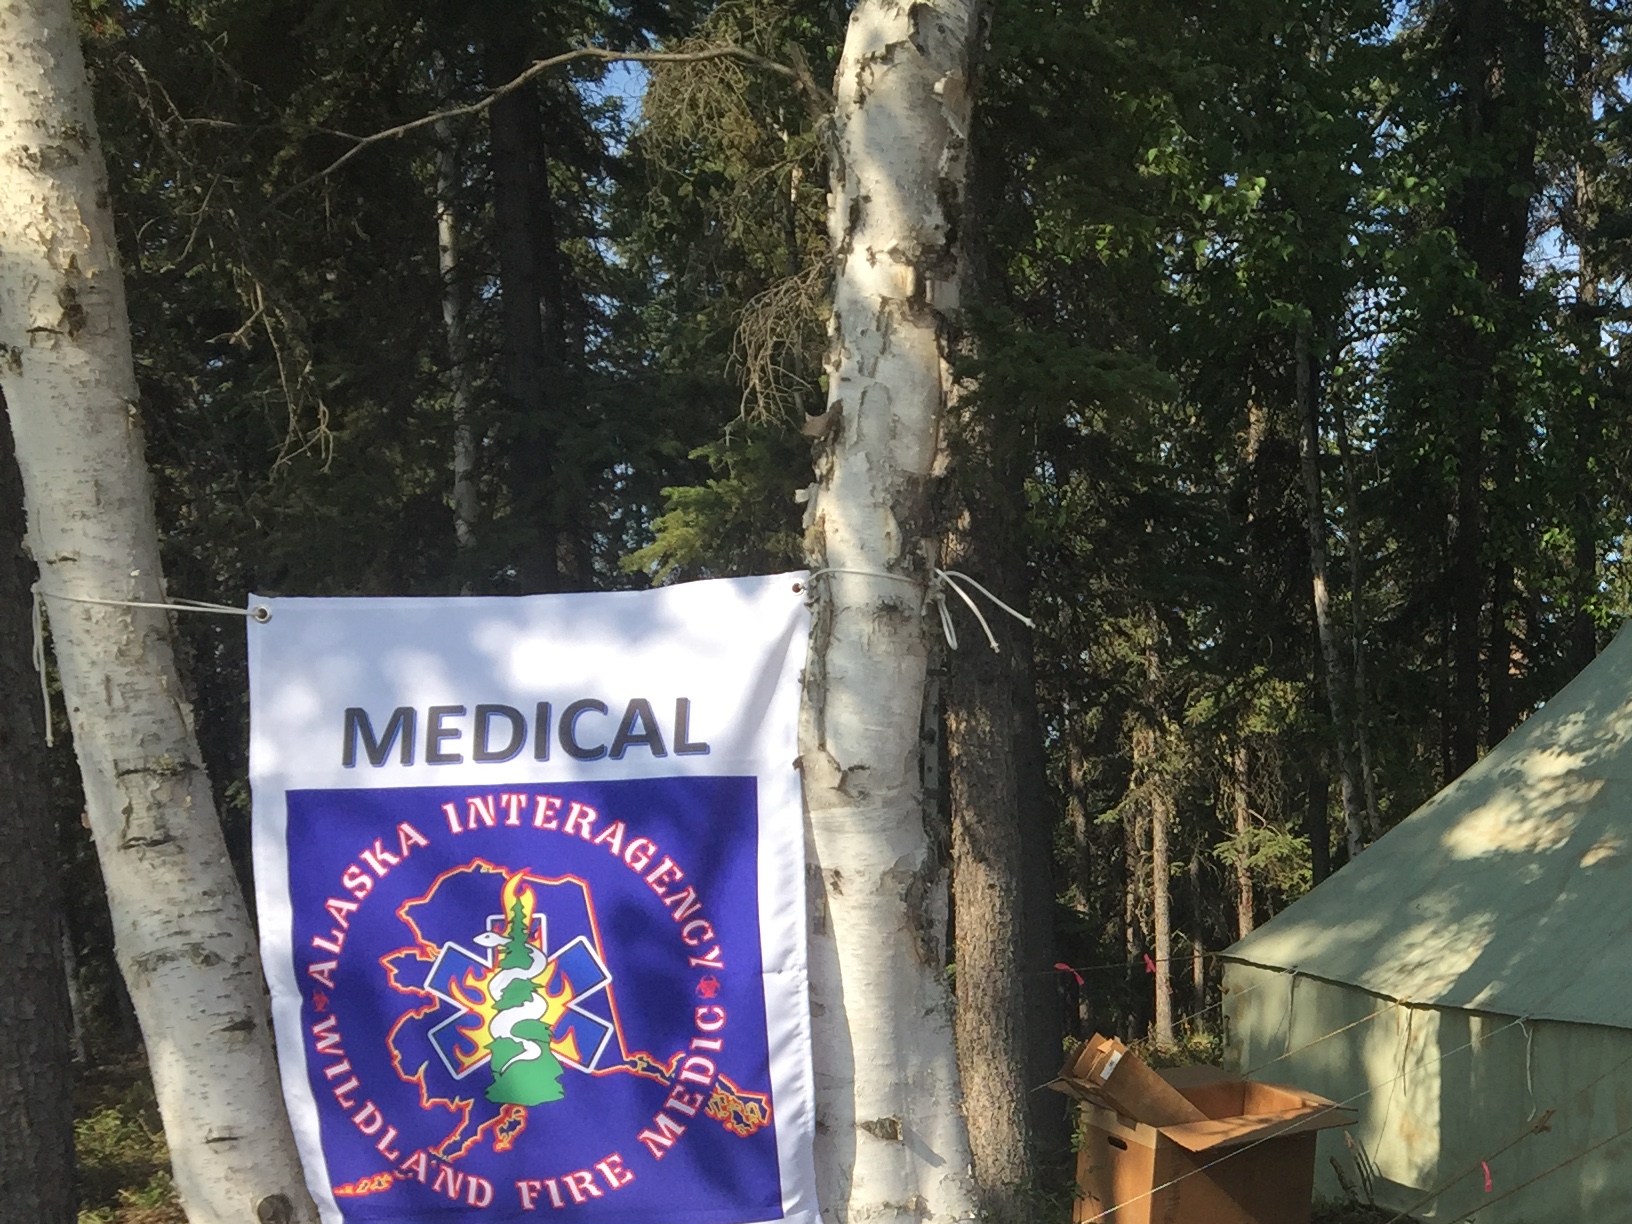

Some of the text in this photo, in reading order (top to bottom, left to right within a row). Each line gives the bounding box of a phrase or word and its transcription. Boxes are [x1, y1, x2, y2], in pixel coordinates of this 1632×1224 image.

[341, 697, 711, 768] MEDICAL
[307, 793, 726, 989] ALASKA INTERAGENCY
[310, 1004, 728, 1211] WILDLAND FIRE MEDIC
